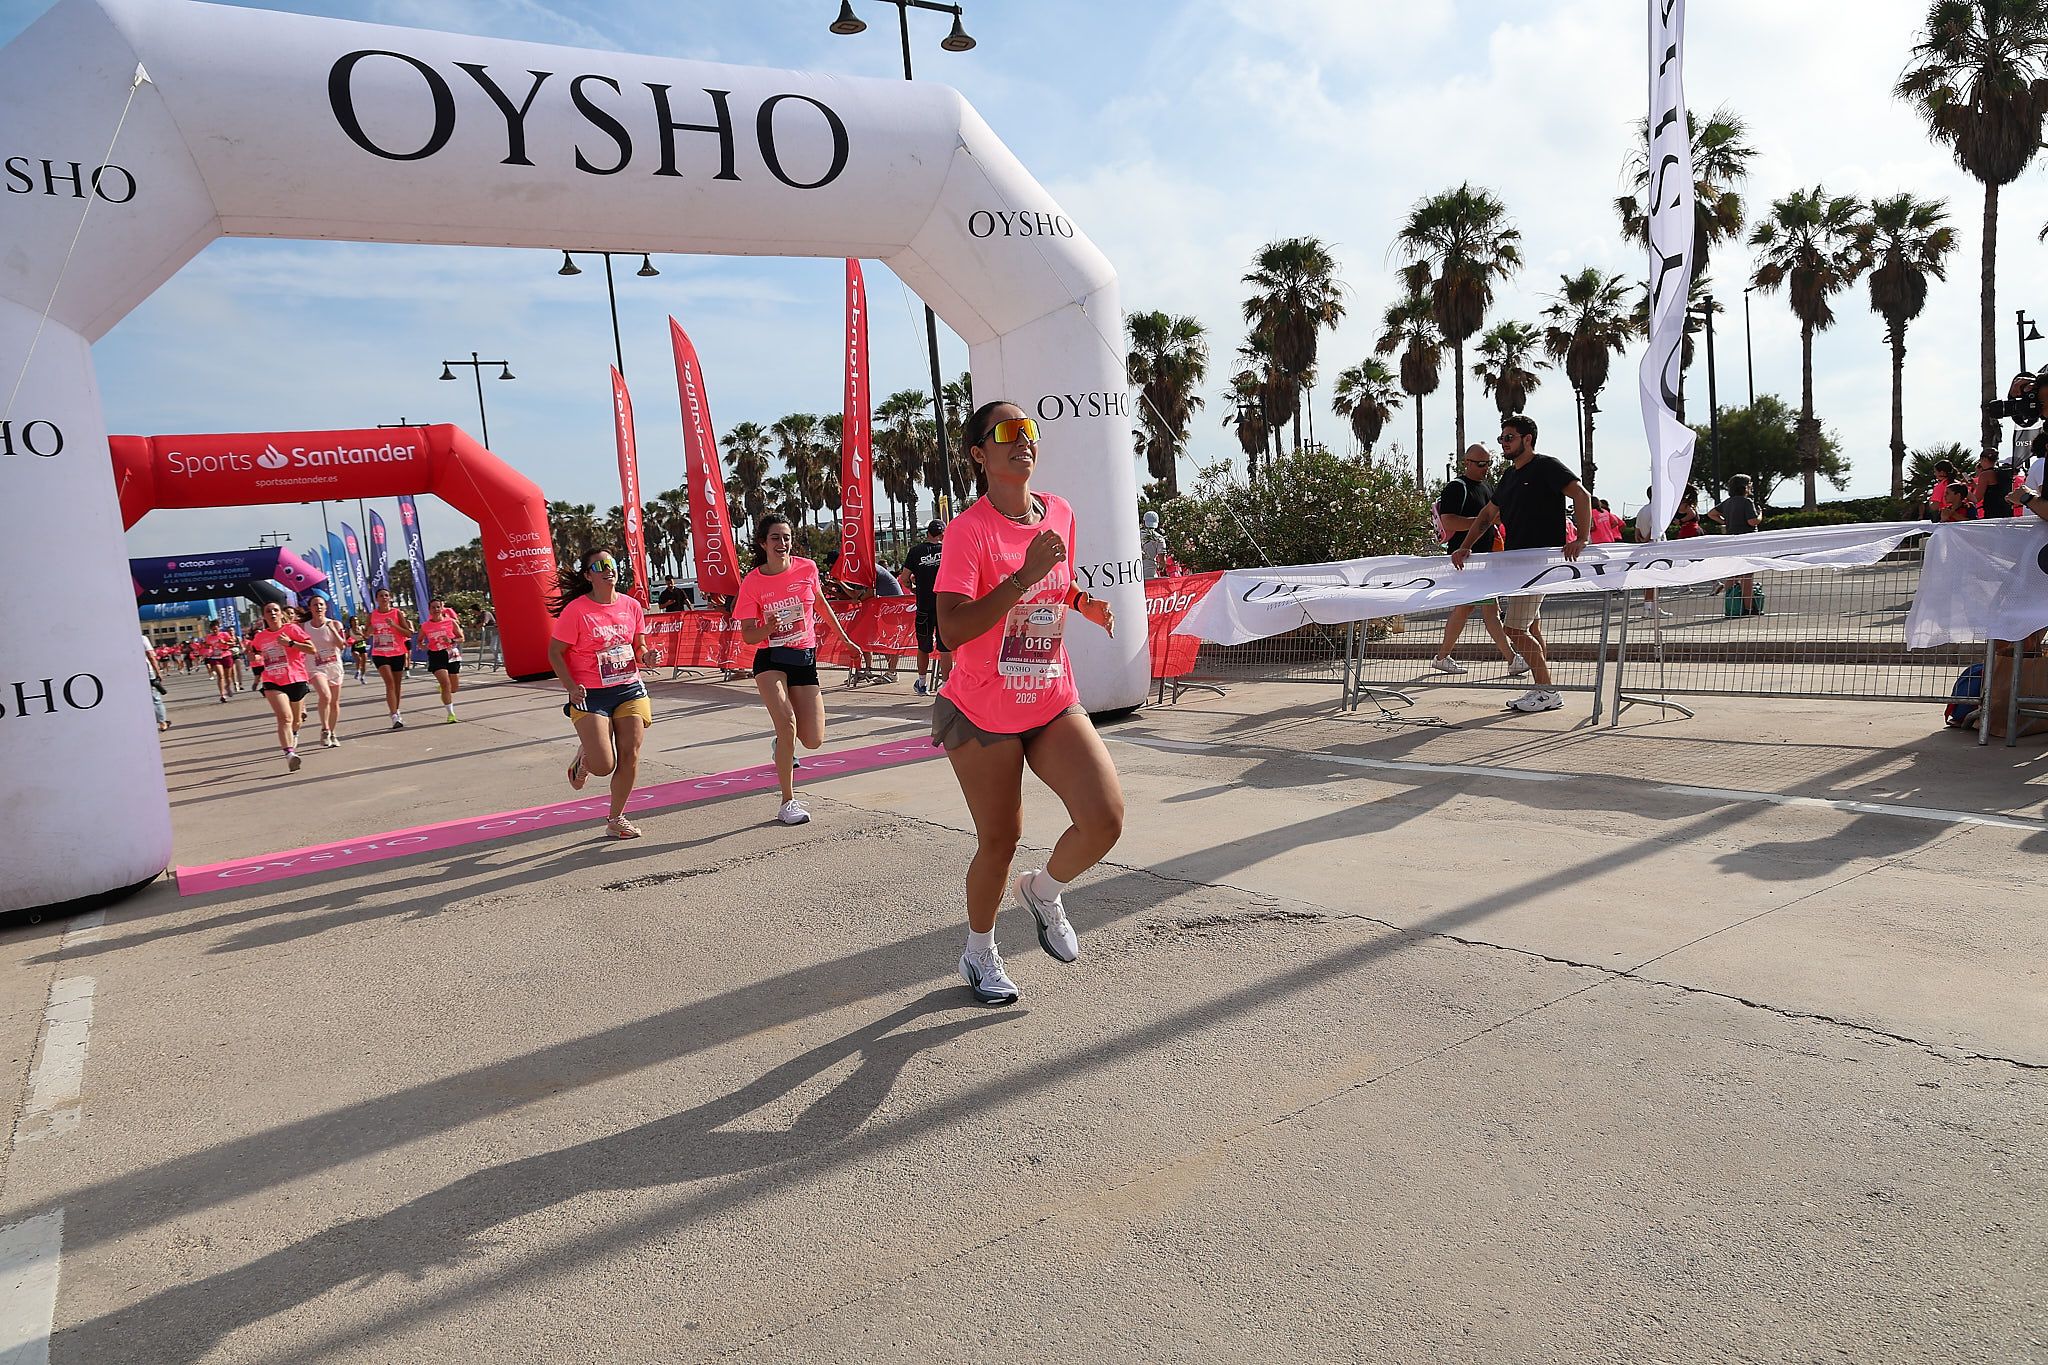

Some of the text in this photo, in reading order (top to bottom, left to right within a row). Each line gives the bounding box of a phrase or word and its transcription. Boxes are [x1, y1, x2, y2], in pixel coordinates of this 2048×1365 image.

[328, 49, 850, 190] OYSHO
[4, 156, 137, 204] SHO
[968, 210, 1074, 239] OYSHO
[1037, 392, 1130, 421] OYSHO
[167, 443, 416, 478] Sports Santander
[255, 474, 338, 487] sportssantander.es
[508, 531, 541, 544] Sports
[508, 546, 552, 559] Santander
[990, 552, 1022, 562] OYSHO
[1074, 559, 1142, 588] YSHO
[592, 624, 629, 638] CARRERA
[779, 623, 794, 632] 016
[1025, 637, 1052, 651] 016
[612, 661, 628, 669] 016
[1006, 665, 1031, 673] OYSHO
[1015, 692, 1037, 704] 2026
[217, 835, 429, 878] OYSHO
